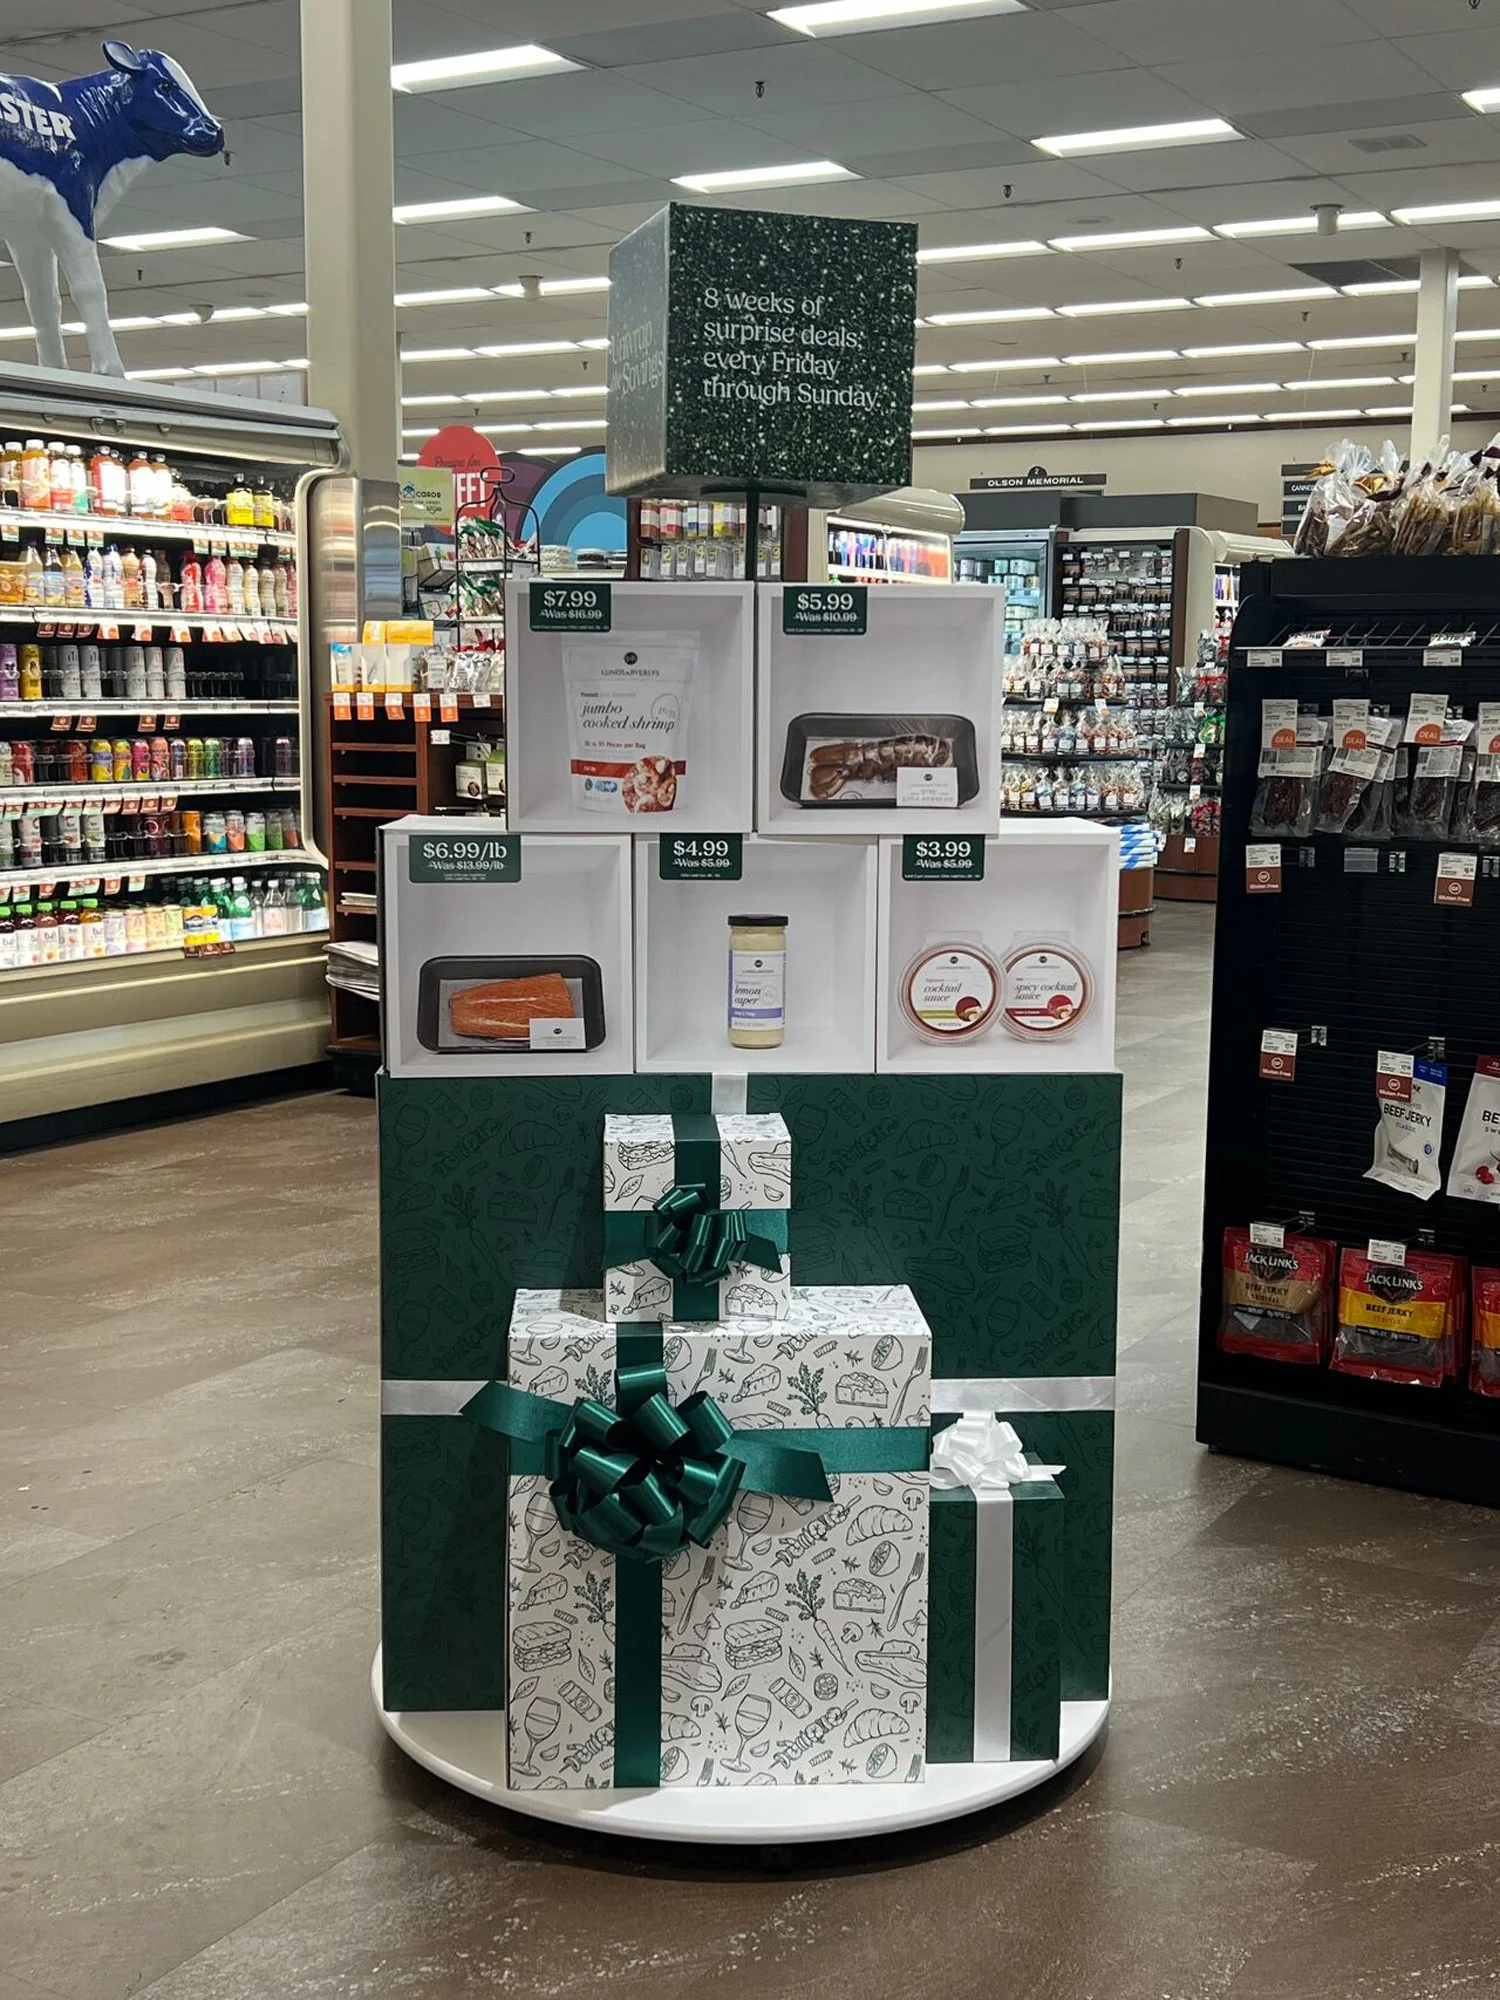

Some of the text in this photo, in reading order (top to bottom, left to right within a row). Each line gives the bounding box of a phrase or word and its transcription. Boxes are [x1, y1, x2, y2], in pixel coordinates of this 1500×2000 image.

[0, 92, 76, 141] STER
[704, 288, 823, 316] 8 weeks of
[703, 322, 795, 345] surprise
[703, 352, 841, 381] every Friday
[703, 376, 790, 406] through
[987, 476, 1084, 487] OLSON MEMORIAL
[452, 472, 488, 508] EET
[543, 589, 597, 608] $7.99
[797, 592, 853, 611] $5.99
[541, 609, 602, 620] Was $16.99
[795, 612, 857, 622] Was $10.99
[581, 701, 623, 718] jumbo
[583, 716, 675, 734] cooked shrimp
[1275, 735, 1293, 743] DEAL
[423, 841, 507, 861] $6.99/lb
[673, 840, 729, 857] $4.99
[916, 841, 971, 858] $3.99
[429, 861, 505, 871] Was $13.99/lb
[674, 858, 730, 868] Was $5.99
[916, 859, 973, 869] Was $5.99
[734, 984, 761, 995] lemon
[923, 983, 962, 993] cocktail
[1014, 981, 1078, 994] spicy cocktail
[734, 997, 760, 1007] caper
[1383, 1103, 1432, 1127] BEEF JERKY
[1244, 1252, 1268, 1266] JACK
[1363, 1272, 1391, 1287] JACK
[1262, 1285, 1289, 1296] JERKY
[1366, 1303, 1414, 1318] BEEF JERKY
